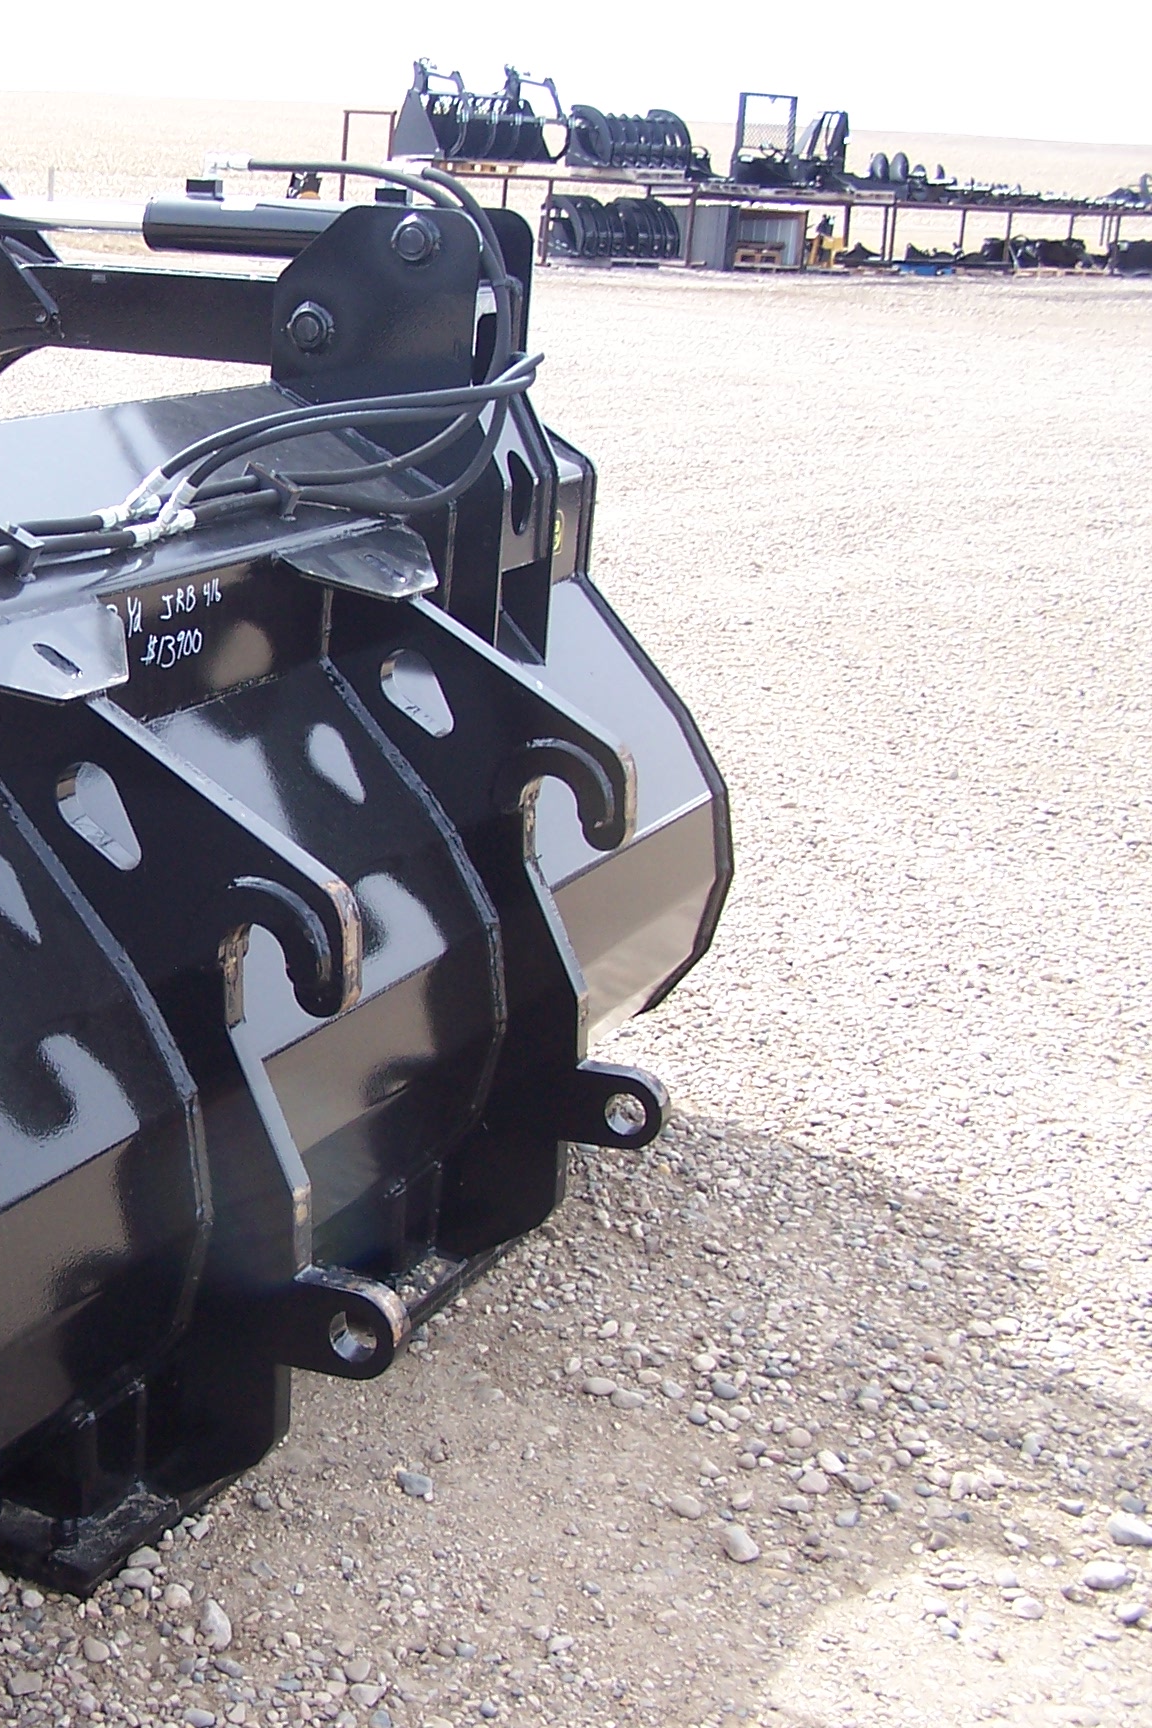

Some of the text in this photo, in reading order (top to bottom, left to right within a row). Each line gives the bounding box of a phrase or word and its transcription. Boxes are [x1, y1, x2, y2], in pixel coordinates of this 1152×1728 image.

[127, 578, 222, 638] Yd JRB 416
[140, 628, 203, 668] $13900
